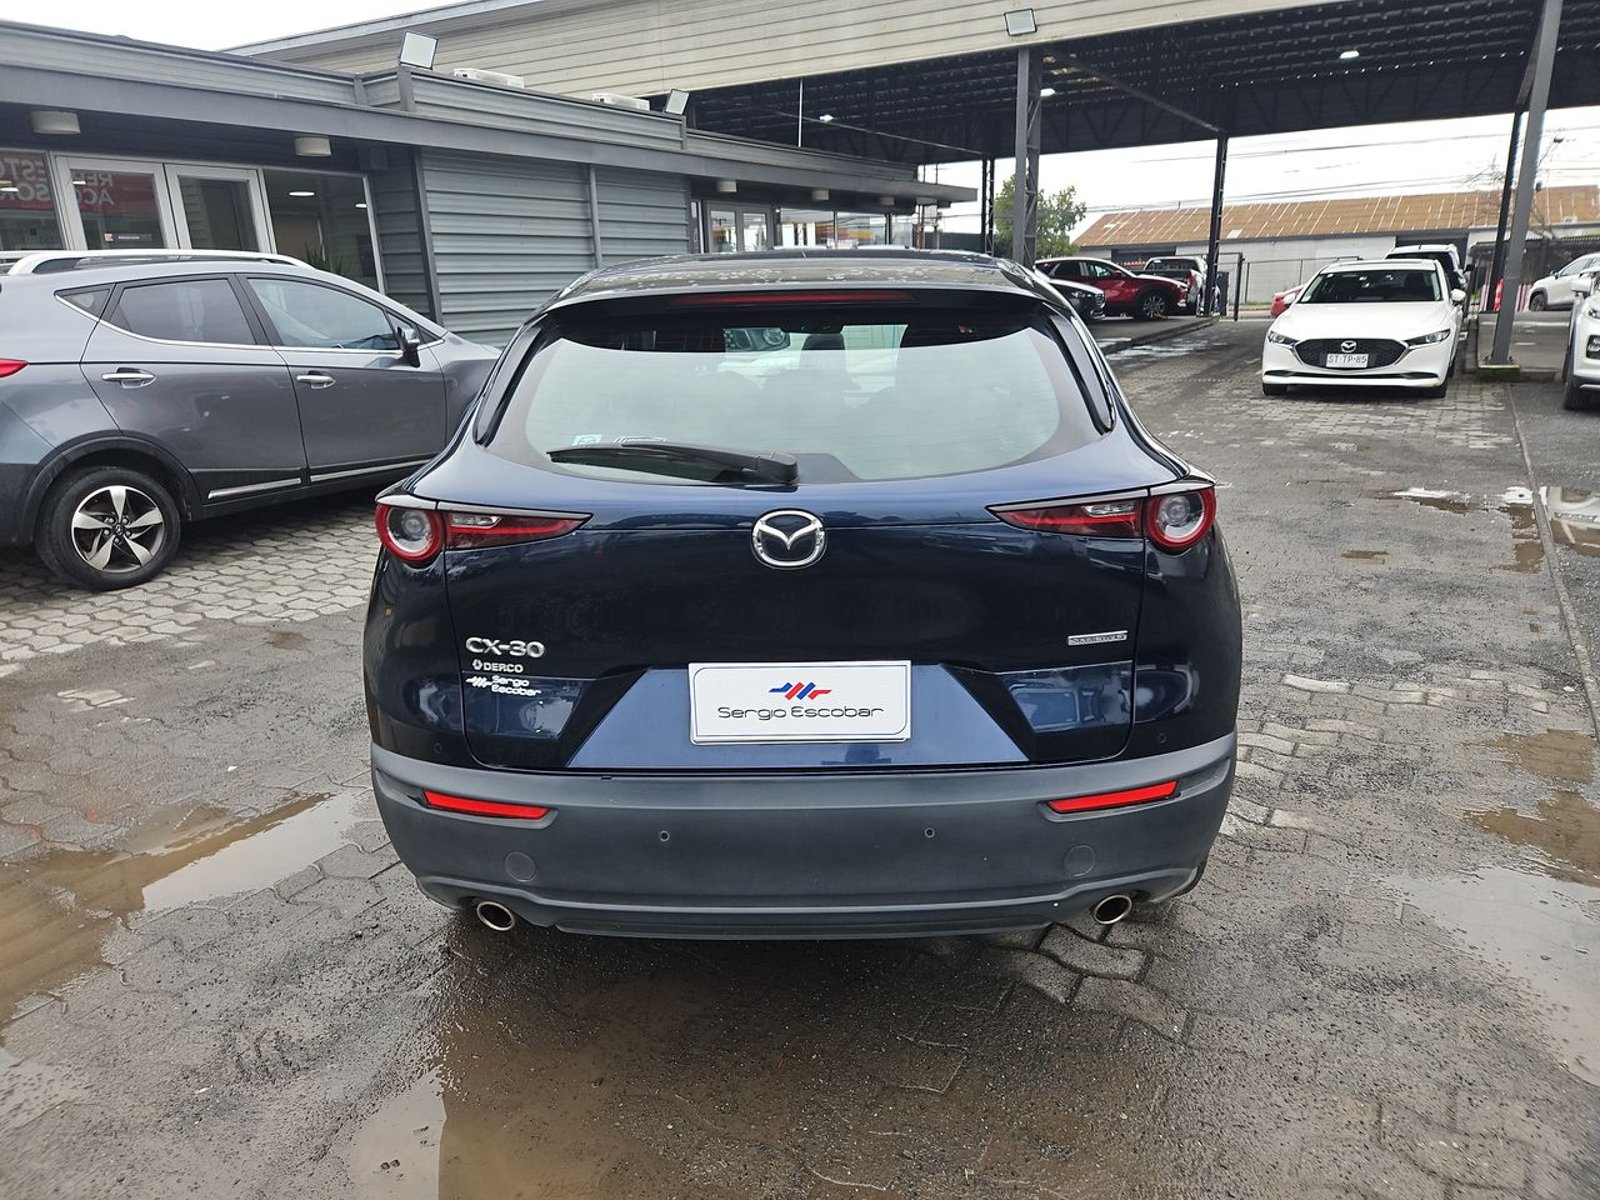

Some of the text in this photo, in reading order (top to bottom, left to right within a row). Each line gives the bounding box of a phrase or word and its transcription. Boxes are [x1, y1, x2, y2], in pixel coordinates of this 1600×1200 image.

[465, 636, 545, 658] CX-30
[483, 661, 524, 673] DERCO
[491, 684, 542, 696] Escobar
[717, 705, 885, 721] Sergio Escobar
